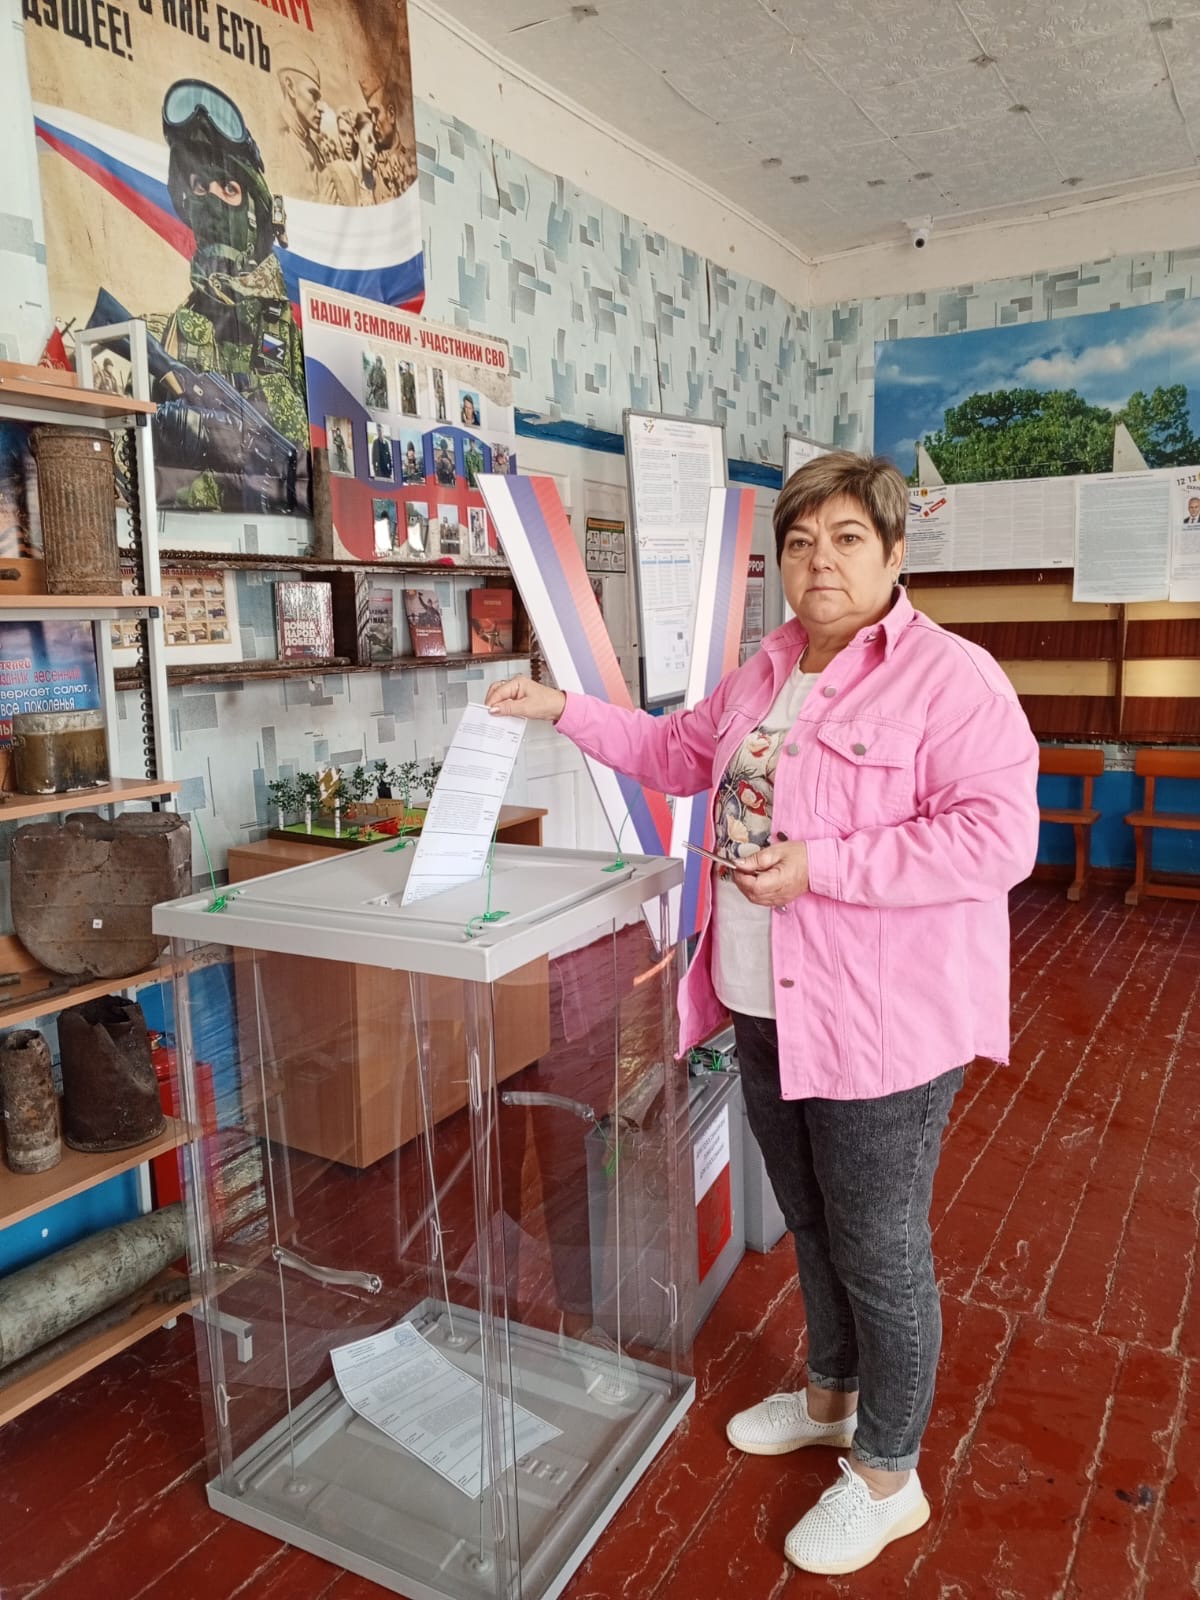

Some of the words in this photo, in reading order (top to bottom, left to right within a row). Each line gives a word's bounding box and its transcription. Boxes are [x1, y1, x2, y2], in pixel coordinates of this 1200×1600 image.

[162, 0, 209, 43] НАС
[216, 3, 271, 73] ЕСТЬ
[310, 297, 352, 329] НАШИ
[354, 311, 412, 345] ЗЕМЛЯКИ
[419, 329, 483, 363] УЧАСТНИКИ
[484, 346, 505, 368] СВО
[0, 687, 50, 701] веркает
[53, 683, 92, 695] салют,
[0, 702, 20, 717] все
[24, 697, 75, 713] поколенья
